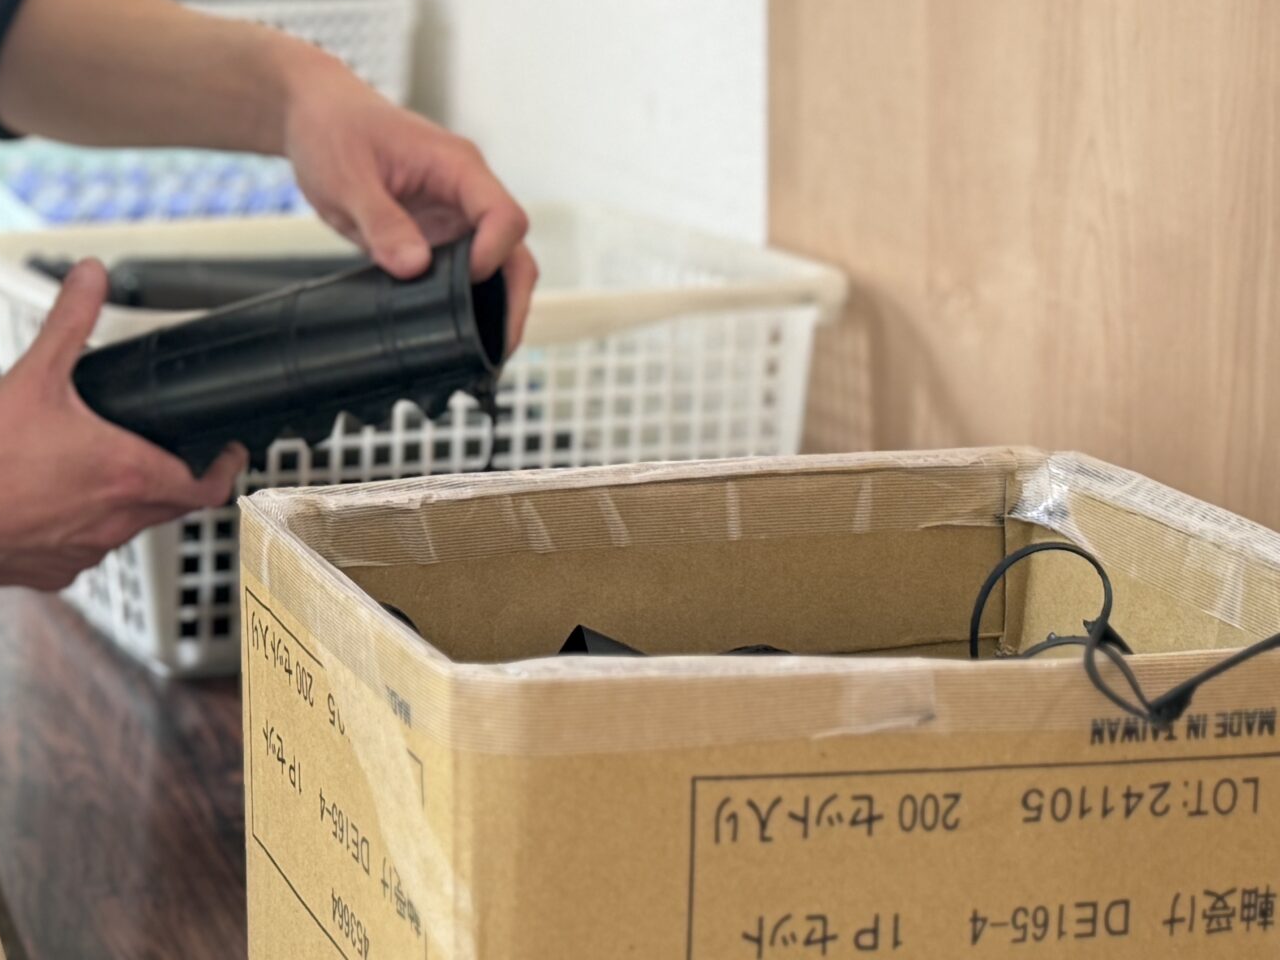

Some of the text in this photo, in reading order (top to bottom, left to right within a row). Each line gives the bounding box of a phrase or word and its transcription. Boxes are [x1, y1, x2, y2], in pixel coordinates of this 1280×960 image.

[251, 611, 314, 707] 200 セット入り
[262, 719, 286, 775] セット
[1186, 713, 1208, 740] IN
[1214, 706, 1277, 738] MADE
[319, 787, 370, 876] DE165-4
[714, 793, 884, 844] セット入り
[898, 792, 962, 832] 200
[331, 887, 369, 960] 453664
[969, 898, 1130, 945] DE165-4
[1162, 884, 1277, 937] 軸受け
[741, 913, 838, 960] セット
